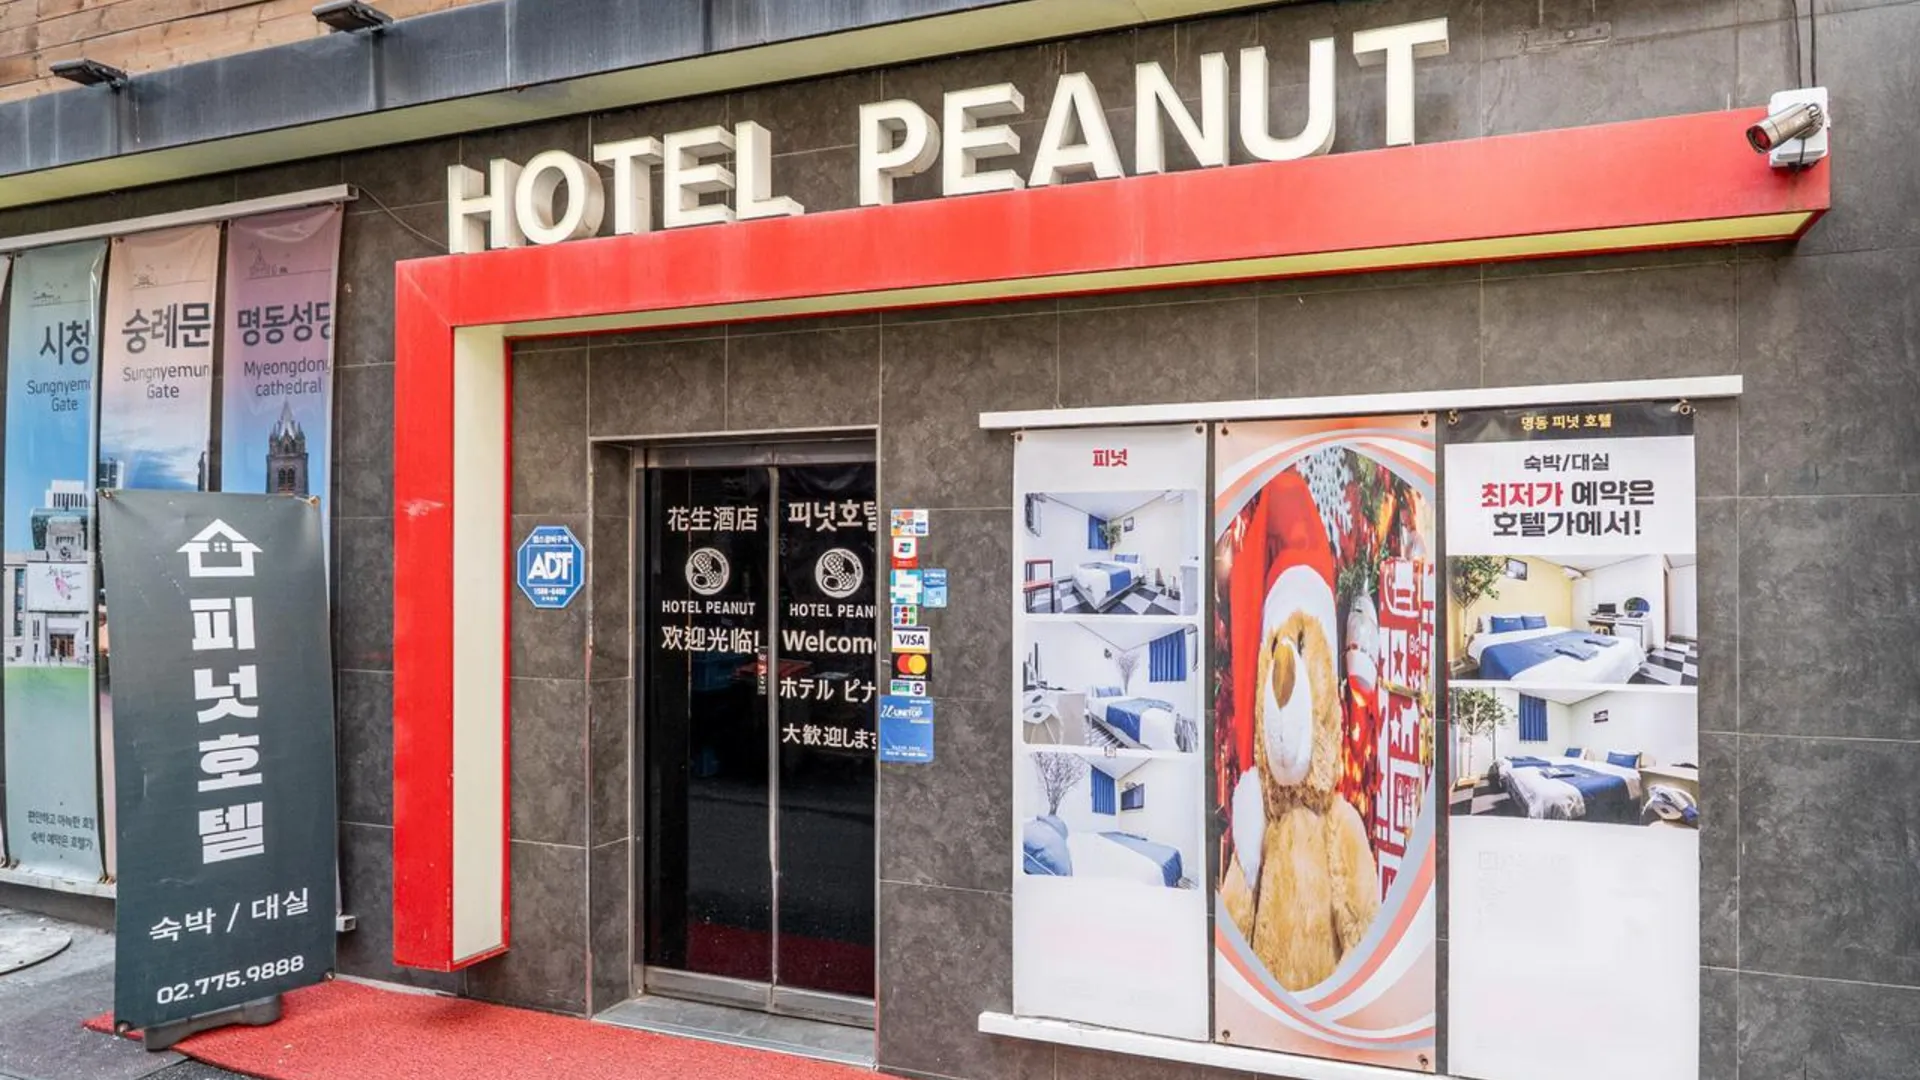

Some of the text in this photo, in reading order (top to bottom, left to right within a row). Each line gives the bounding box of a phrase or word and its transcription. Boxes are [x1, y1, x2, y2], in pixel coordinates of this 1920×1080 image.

[447, 17, 1449, 254] HOTEL PEANUT
[121, 303, 211, 353] 숭례문
[39, 320, 90, 365] 시청
[147, 383, 180, 399] Gate
[256, 377, 322, 397] cathedral
[51, 396, 79, 412] Gate
[1521, 413, 1613, 431] 명동 피넛 호텔
[1093, 449, 1127, 467] 피넛
[1524, 453, 1610, 472] 숙박/대실
[1481, 480, 1655, 508] 최저가 예약은
[667, 506, 759, 532] 花生酒店
[1493, 511, 1641, 537] 호텔가에서!
[527, 551, 573, 580] ADT
[662, 600, 756, 615] HOTEL PEANUT
[789, 604, 877, 618] HOTEL PEAN
[661, 625, 760, 653] 欢迎光临!
[898, 634, 925, 646] VISA
[780, 677, 877, 703] ホテル ピナ
[190, 597, 265, 864] 피넛호텔
[149, 887, 309, 941] 숙박 / 대실
[157, 955, 305, 1004] 02.775.9888
